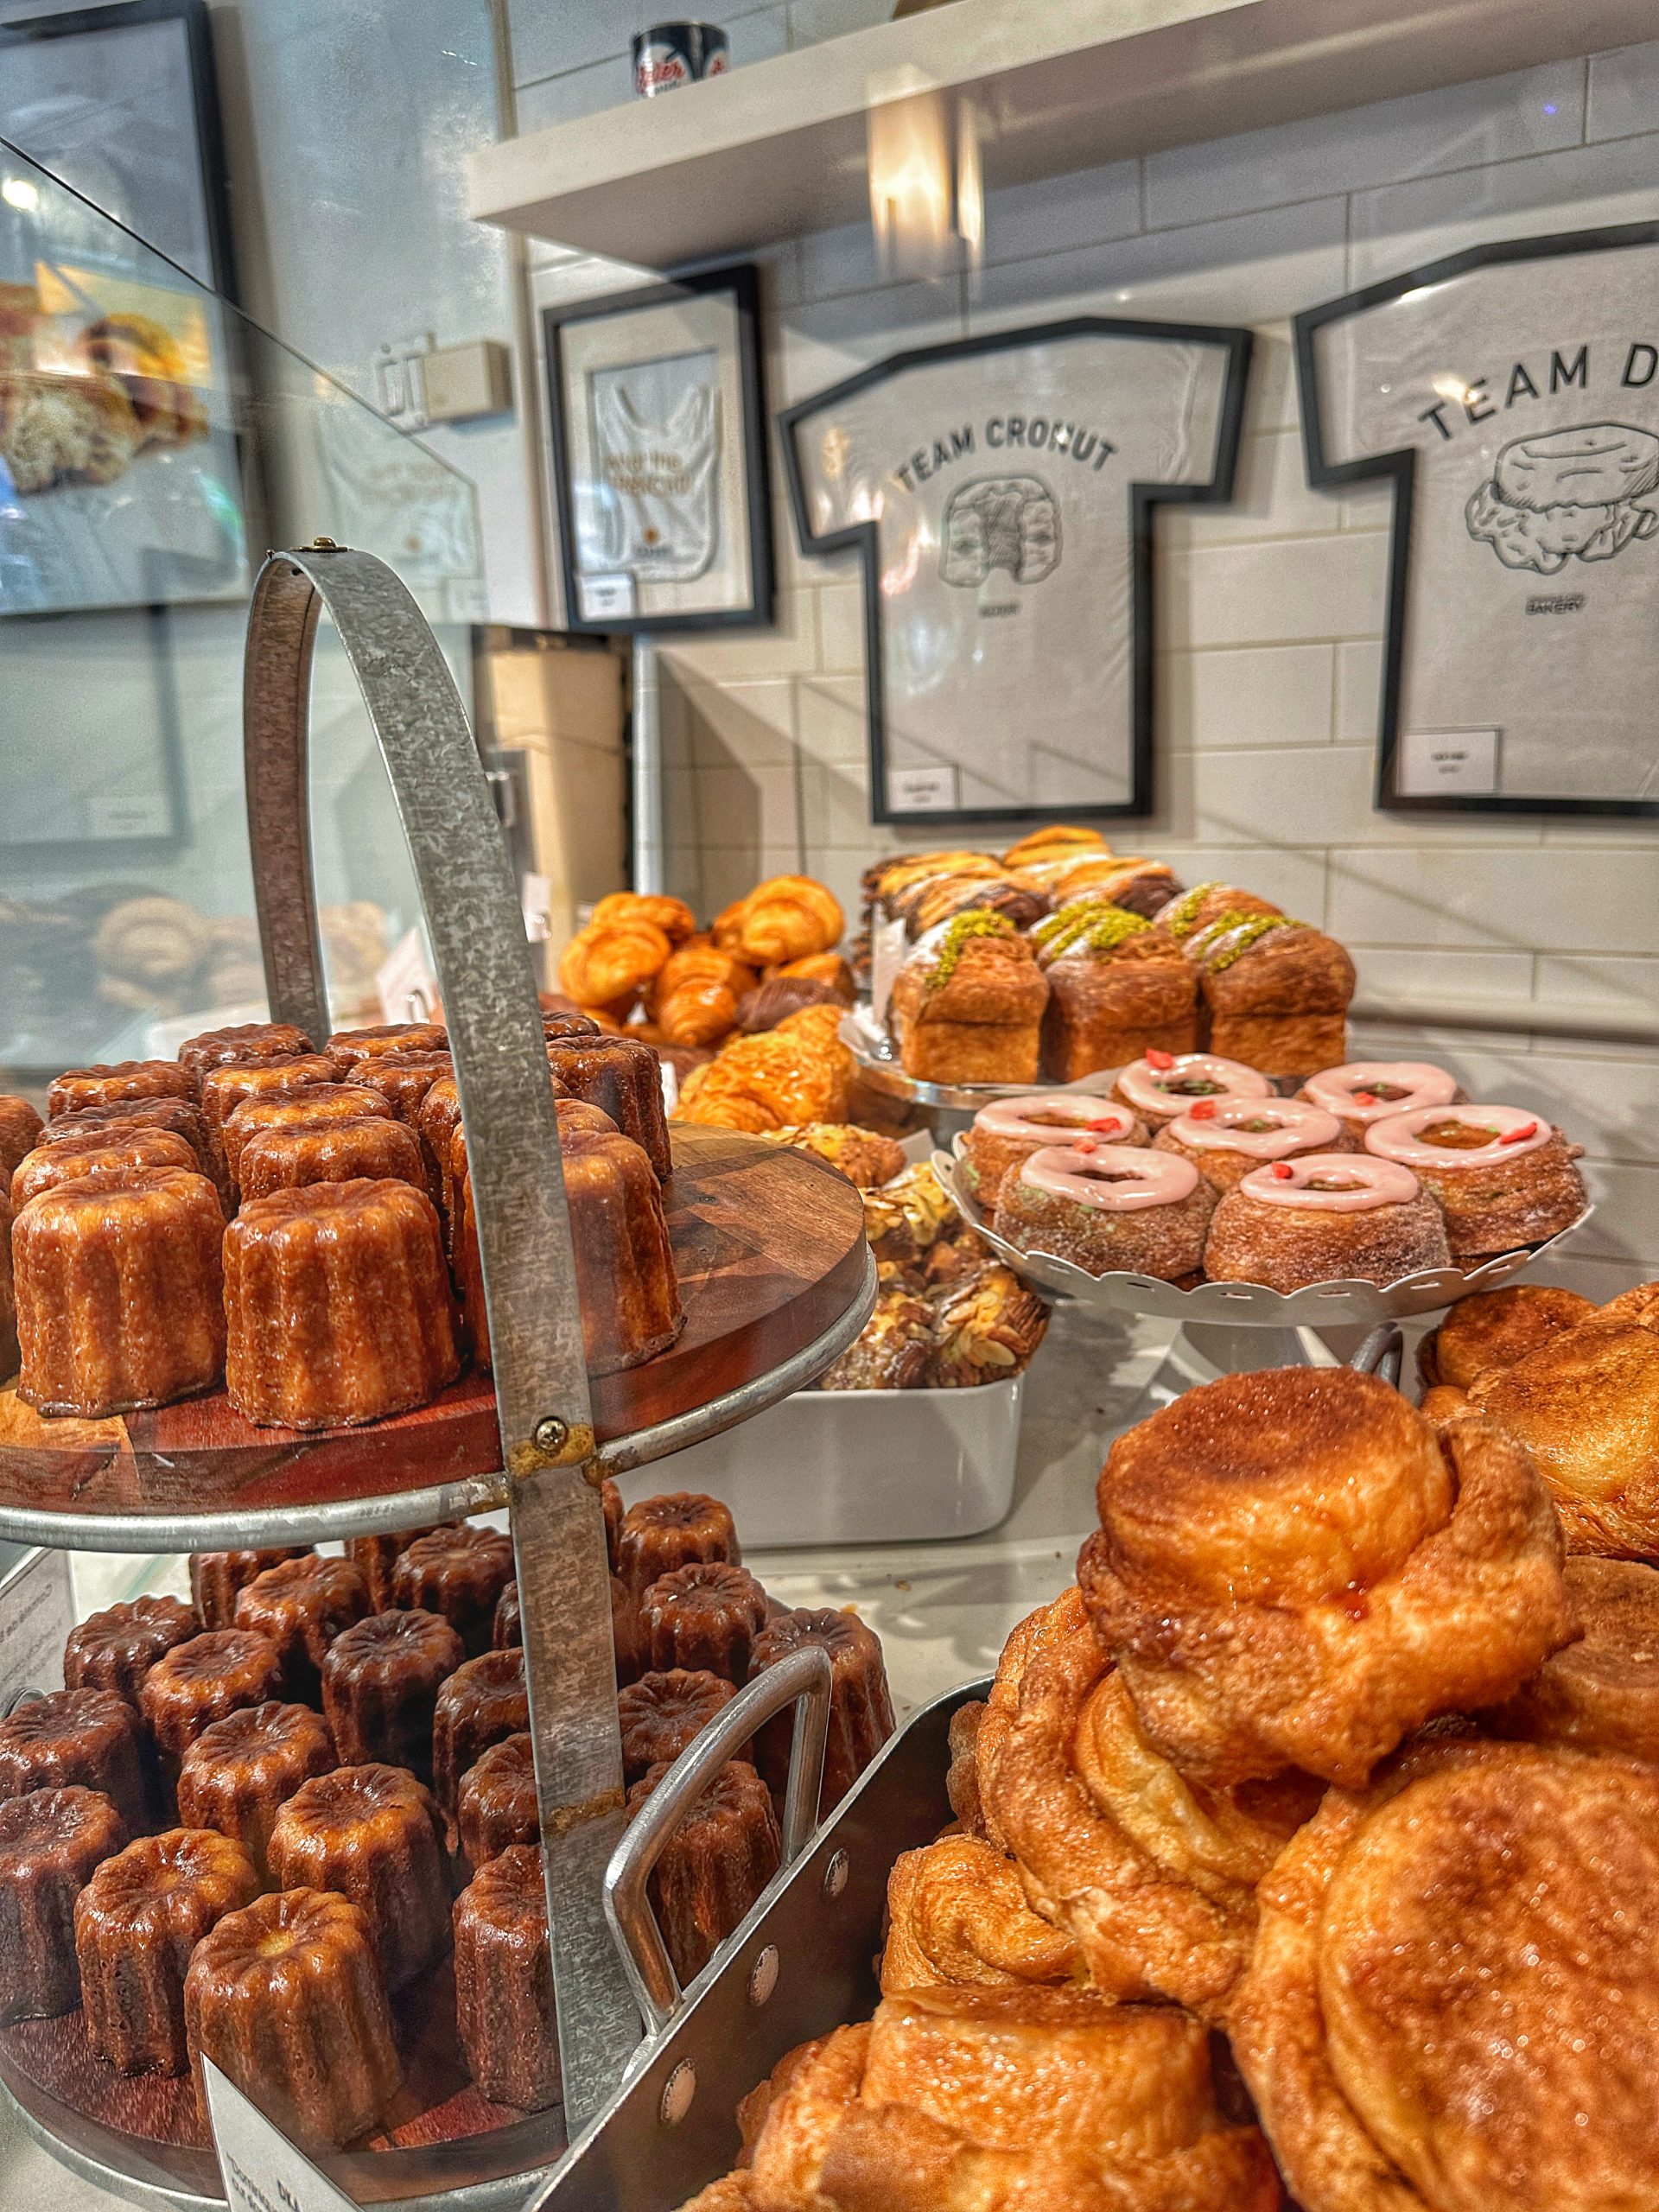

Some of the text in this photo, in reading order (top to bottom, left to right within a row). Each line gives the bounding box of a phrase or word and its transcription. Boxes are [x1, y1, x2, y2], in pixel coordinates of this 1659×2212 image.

[1418, 345, 1588, 441] TEAM
[895, 416, 1118, 493] TEAM CRONUT
